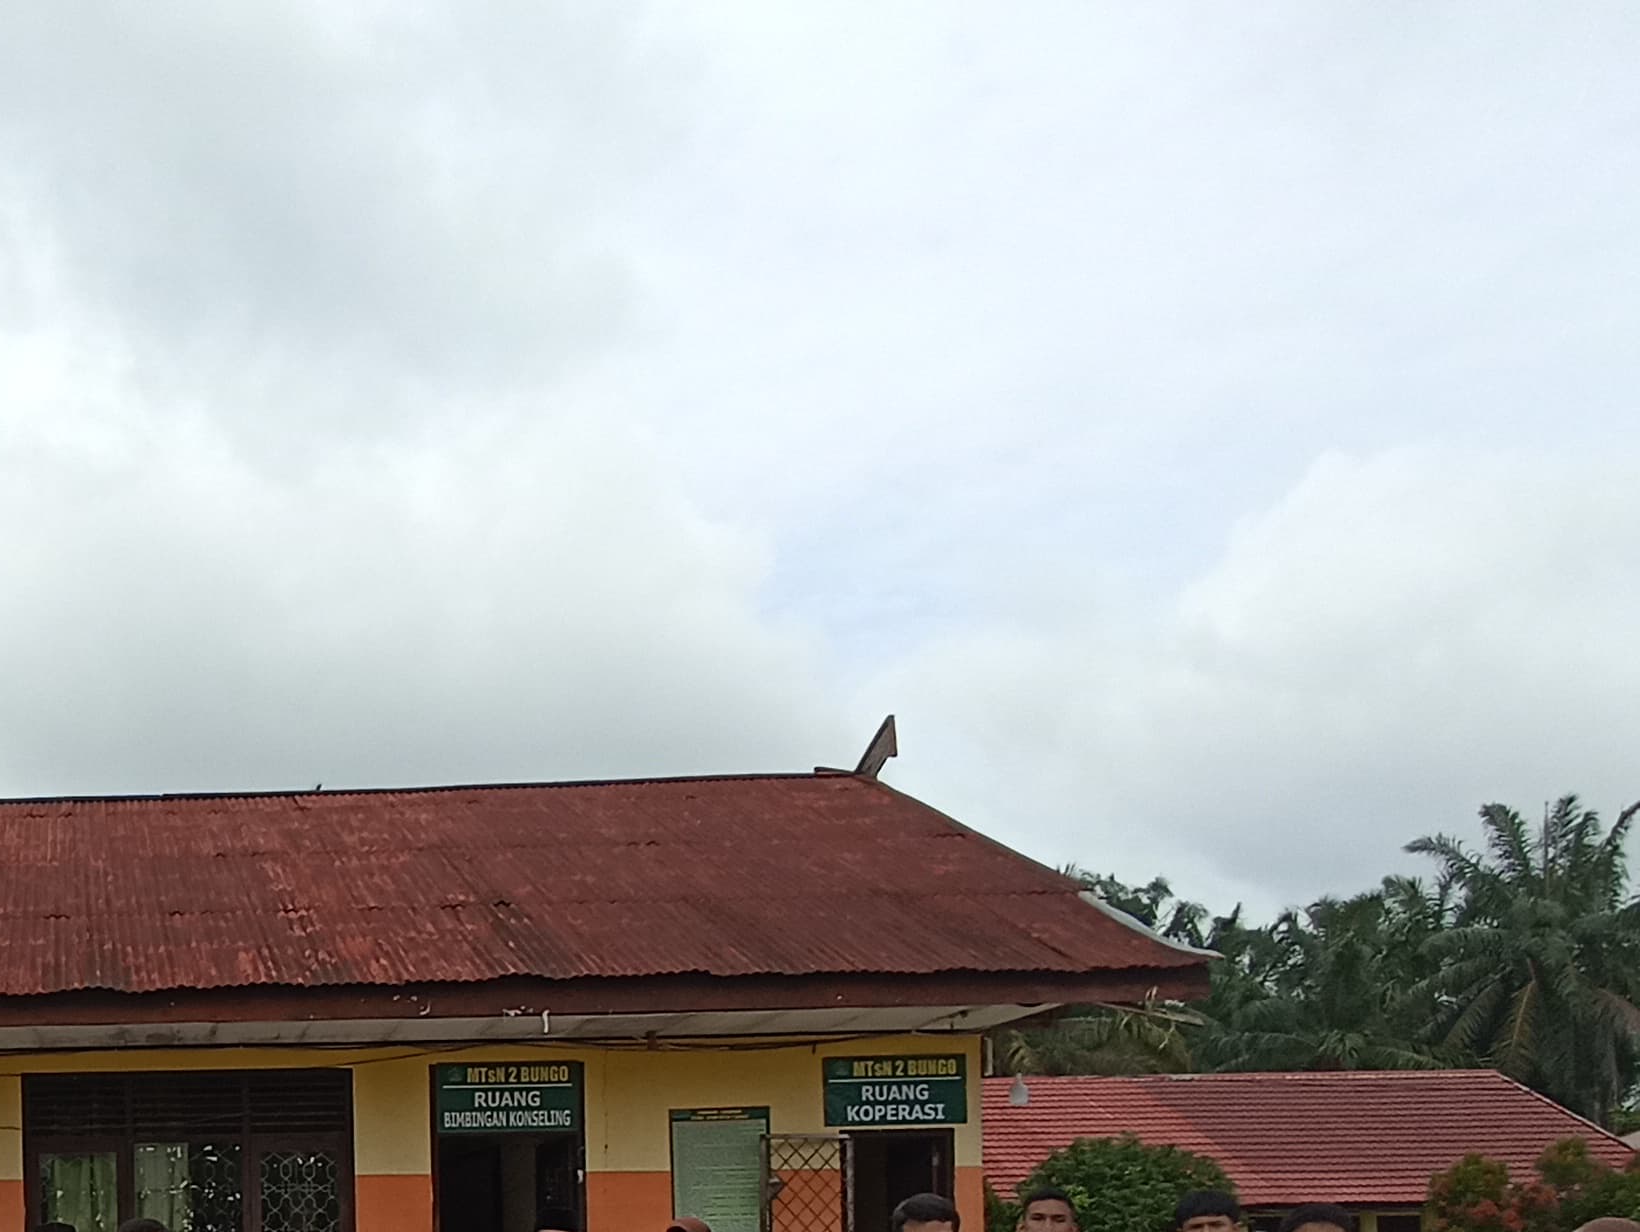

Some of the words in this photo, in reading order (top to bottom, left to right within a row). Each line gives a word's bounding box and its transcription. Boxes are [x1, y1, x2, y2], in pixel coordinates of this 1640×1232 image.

[467, 1067, 505, 1083] MTsN
[508, 1068, 517, 1082] 2
[520, 1065, 569, 1082] BUNGO
[853, 1061, 892, 1077] MTsN
[895, 1061, 904, 1076] 2
[907, 1059, 957, 1075] BUNGO
[474, 1091, 541, 1108] RUANG
[861, 1084, 930, 1101] RUANG
[444, 1110, 507, 1128] BIMBINGAN
[509, 1110, 572, 1127] KONSELING
[847, 1103, 945, 1121] KOPERASI
